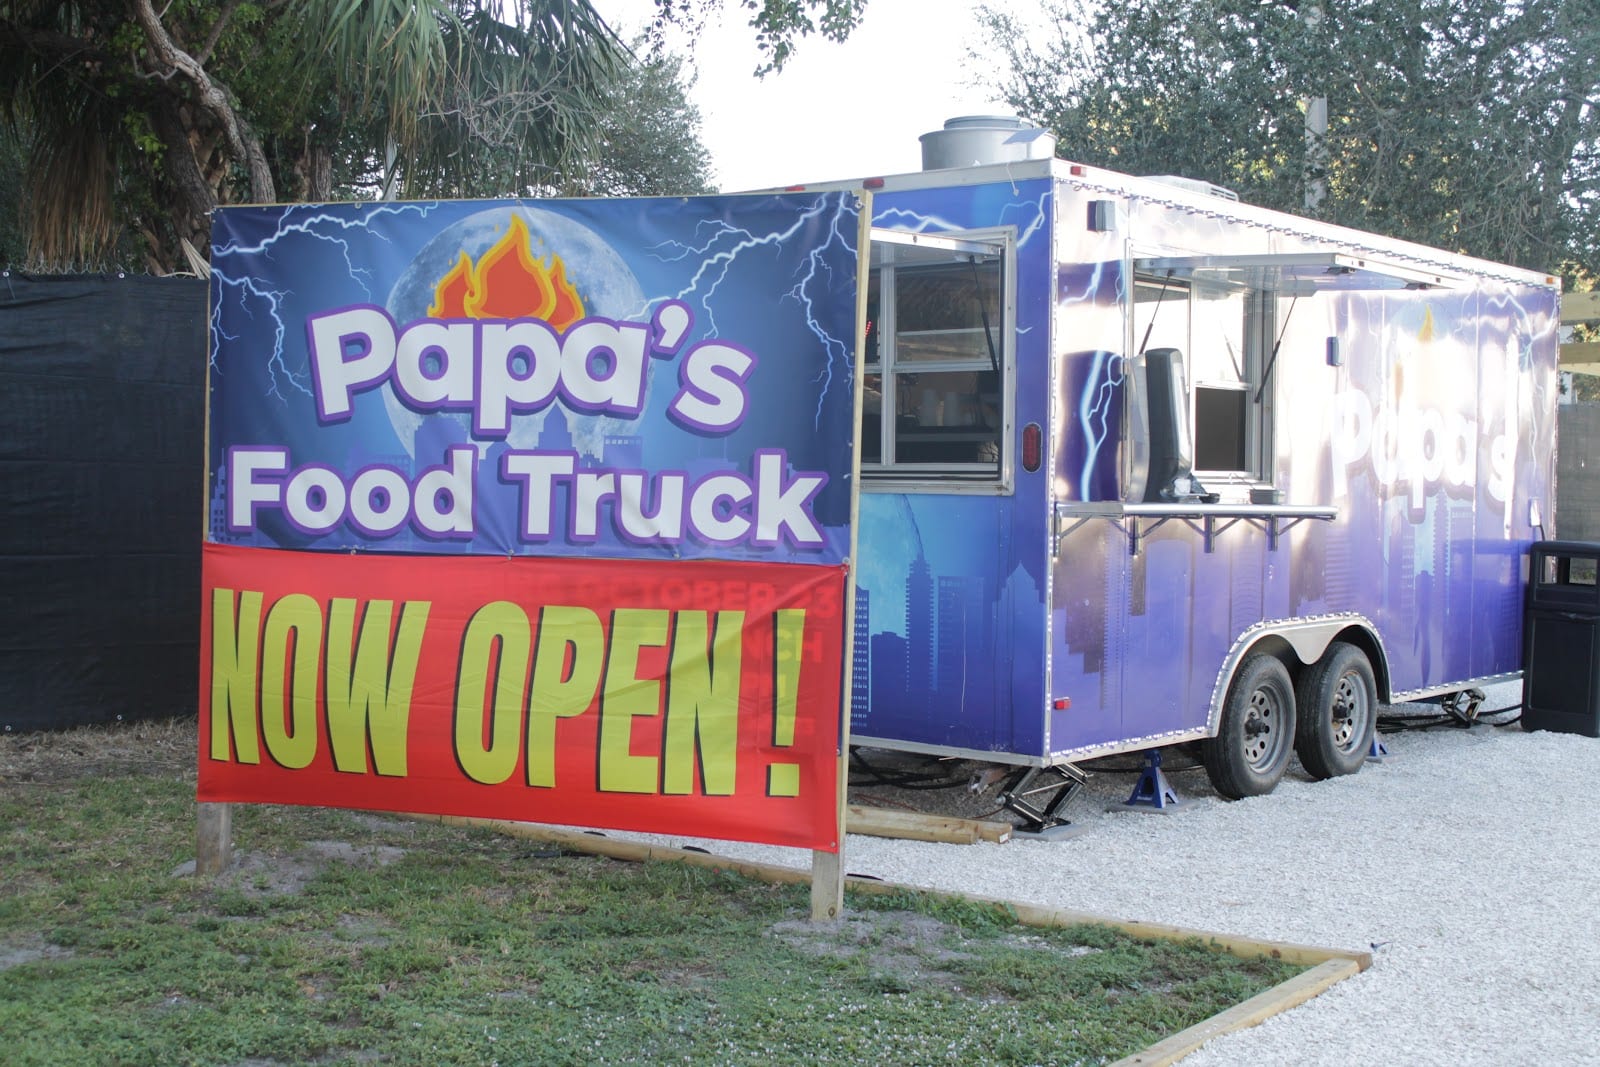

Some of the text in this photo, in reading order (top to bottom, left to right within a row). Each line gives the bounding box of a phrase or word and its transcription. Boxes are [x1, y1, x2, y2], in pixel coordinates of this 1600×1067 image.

[308, 300, 757, 436] Papa's
[228, 445, 827, 546] Food Truck
[210, 588, 431, 778] NOW
